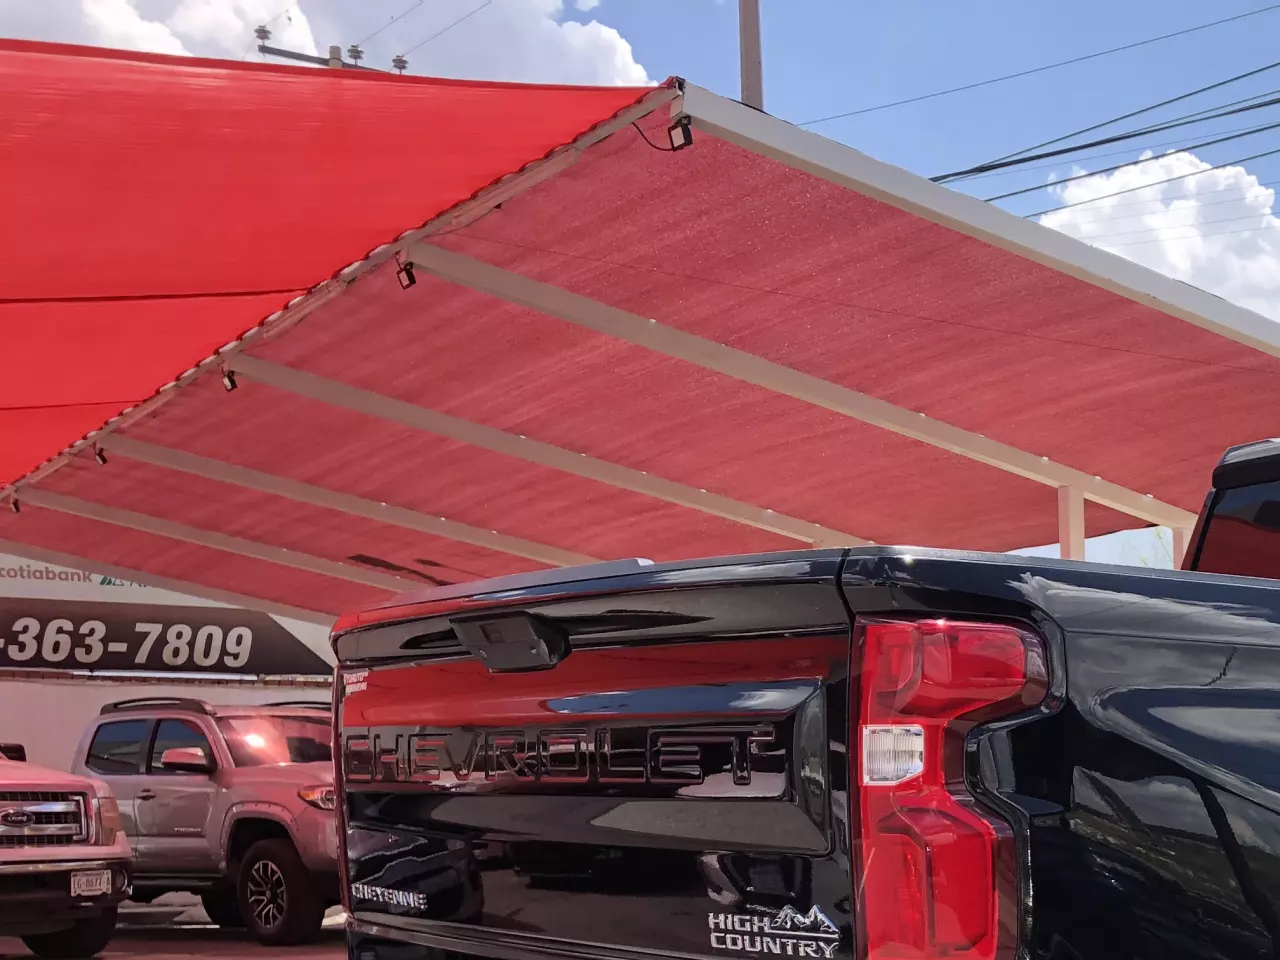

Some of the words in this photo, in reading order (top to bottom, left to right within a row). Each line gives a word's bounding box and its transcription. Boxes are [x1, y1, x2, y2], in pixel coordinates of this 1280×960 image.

[0, 617, 253, 667] 363-7809
[345, 722, 775, 786] CHEVROLET
[351, 882, 428, 910] CHEYENNE
[708, 912, 771, 933] HIGH
[710, 932, 840, 959] COUNTRY
